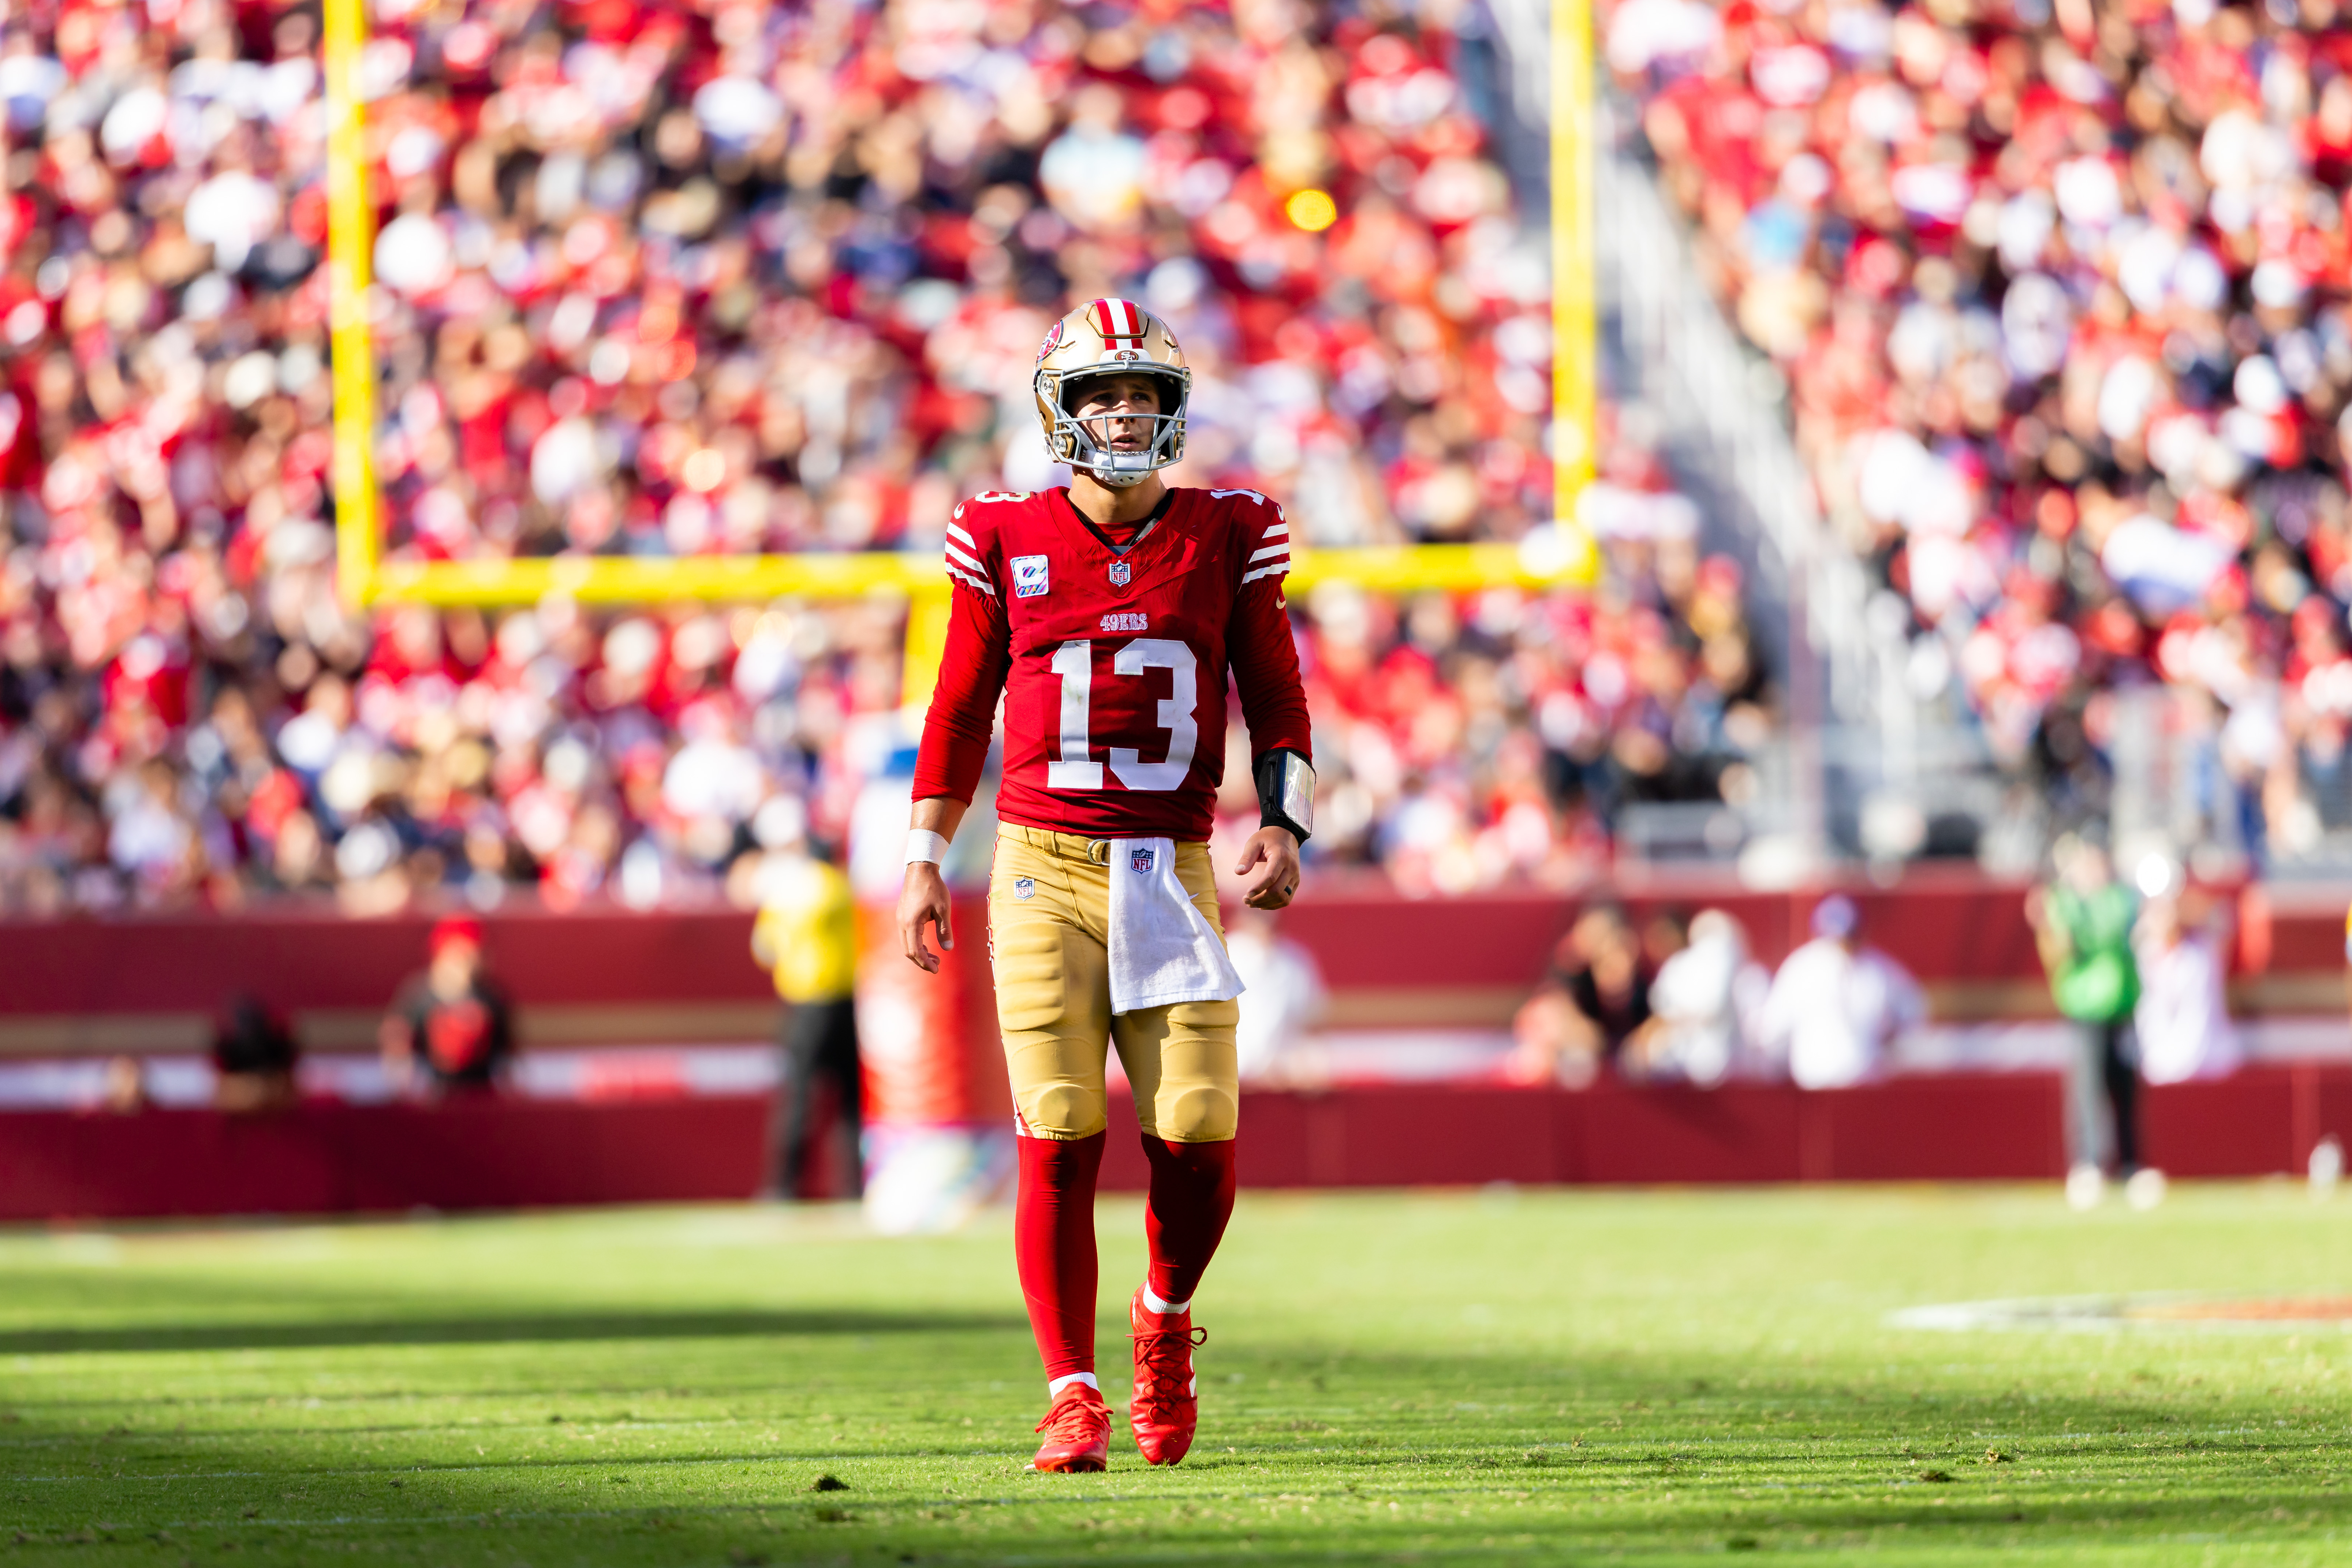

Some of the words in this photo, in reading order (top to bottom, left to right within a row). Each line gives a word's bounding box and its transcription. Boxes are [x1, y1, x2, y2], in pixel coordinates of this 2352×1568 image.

[1013, 557, 1046, 587] C
[1113, 572, 1127, 582] NFL
[1100, 613, 1148, 631] 49ERS
[1047, 638, 1197, 791] 13
[1133, 858, 1151, 871] NFL
[1018, 887, 1031, 896] NFL
